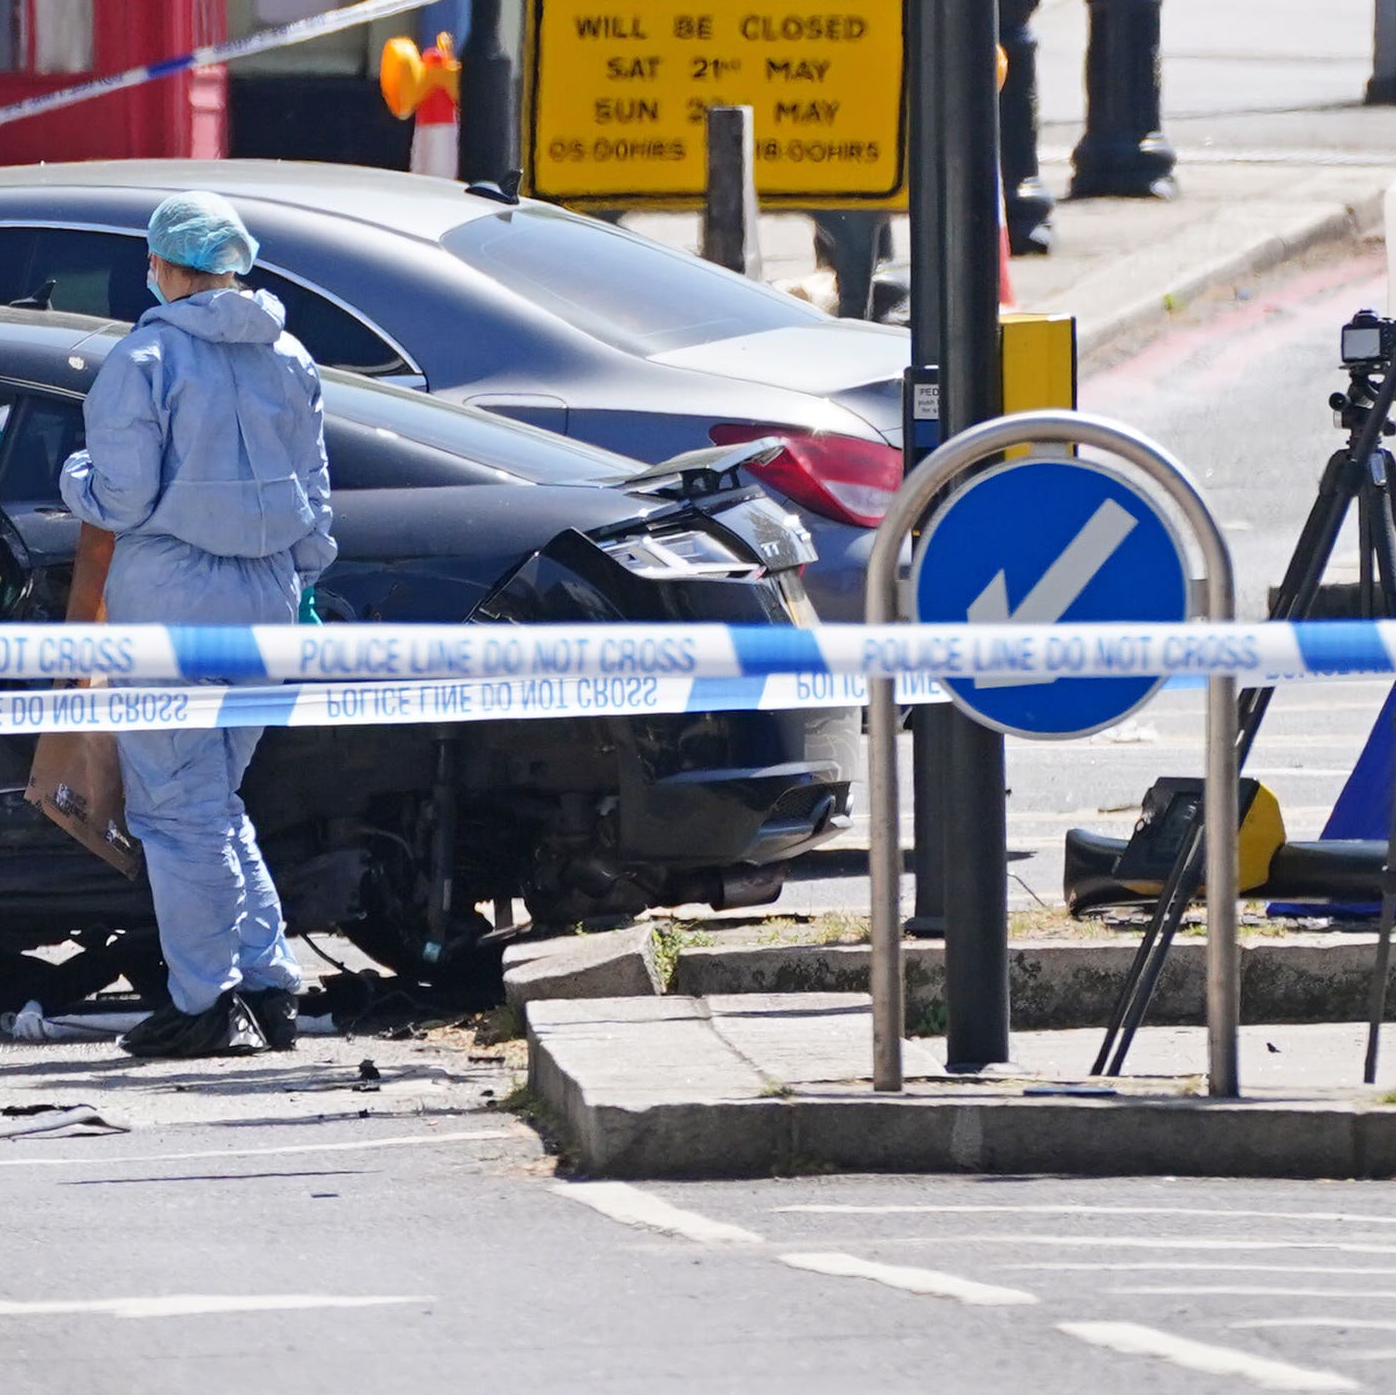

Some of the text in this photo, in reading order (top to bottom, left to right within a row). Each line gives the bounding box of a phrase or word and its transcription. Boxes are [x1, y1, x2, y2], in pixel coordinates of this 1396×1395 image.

[575, 14, 869, 42] WILL BE CLOSED
[606, 58, 663, 80] SAT
[765, 57, 832, 83] MAY
[593, 101, 659, 125] SUN
[774, 101, 842, 125] MAY
[40, 637, 133, 674] CROSS
[299, 638, 695, 674] POLICE LINE DO NOT CROSS
[861, 637, 962, 673] POLICE
[973, 637, 1034, 673] LINE
[1045, 636, 1084, 672] DO
[1095, 635, 1152, 671] NOT
[1163, 634, 1259, 670] CROSS
